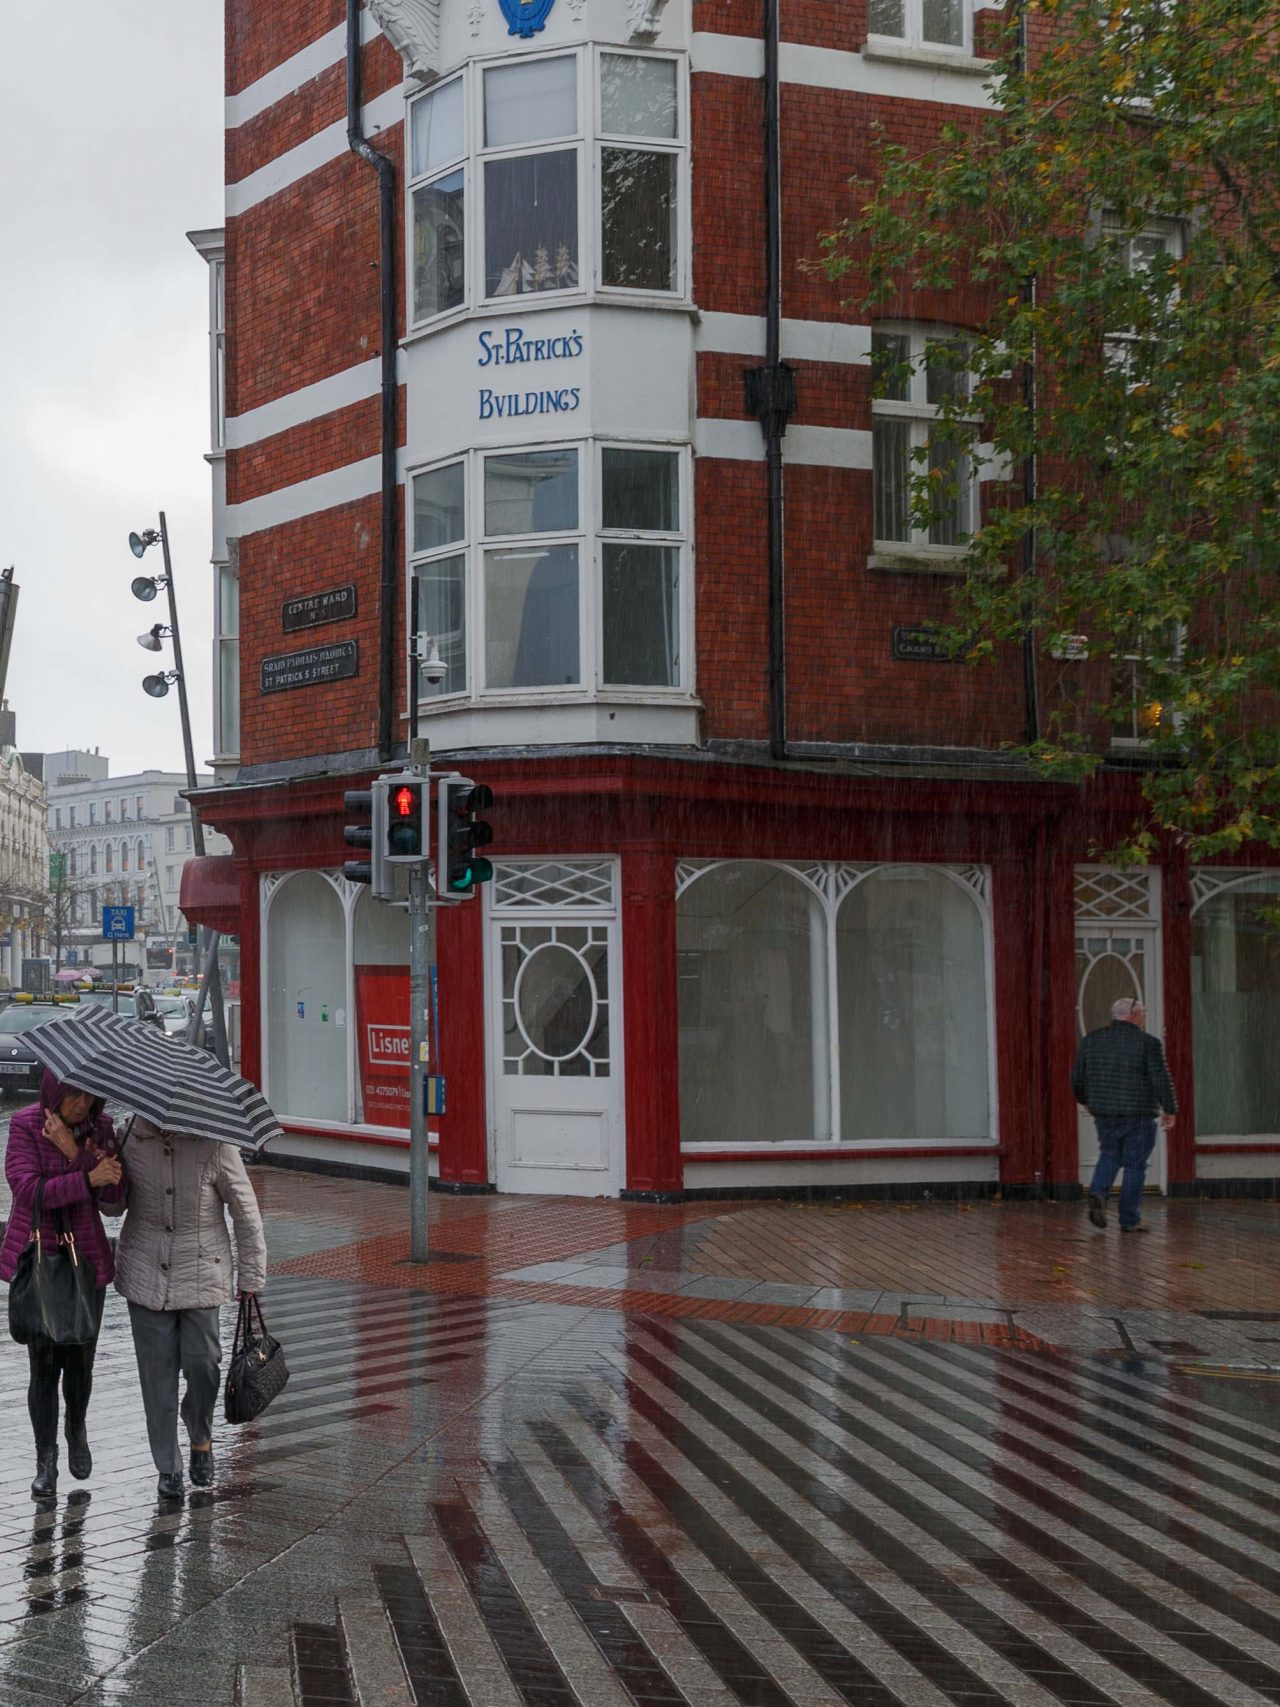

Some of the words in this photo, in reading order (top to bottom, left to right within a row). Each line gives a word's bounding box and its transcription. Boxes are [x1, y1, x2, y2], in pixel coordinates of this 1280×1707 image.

[322, 591, 348, 606] WARD
[312, 664, 340, 678] STREET
[371, 1032, 411, 1054] Lisne
